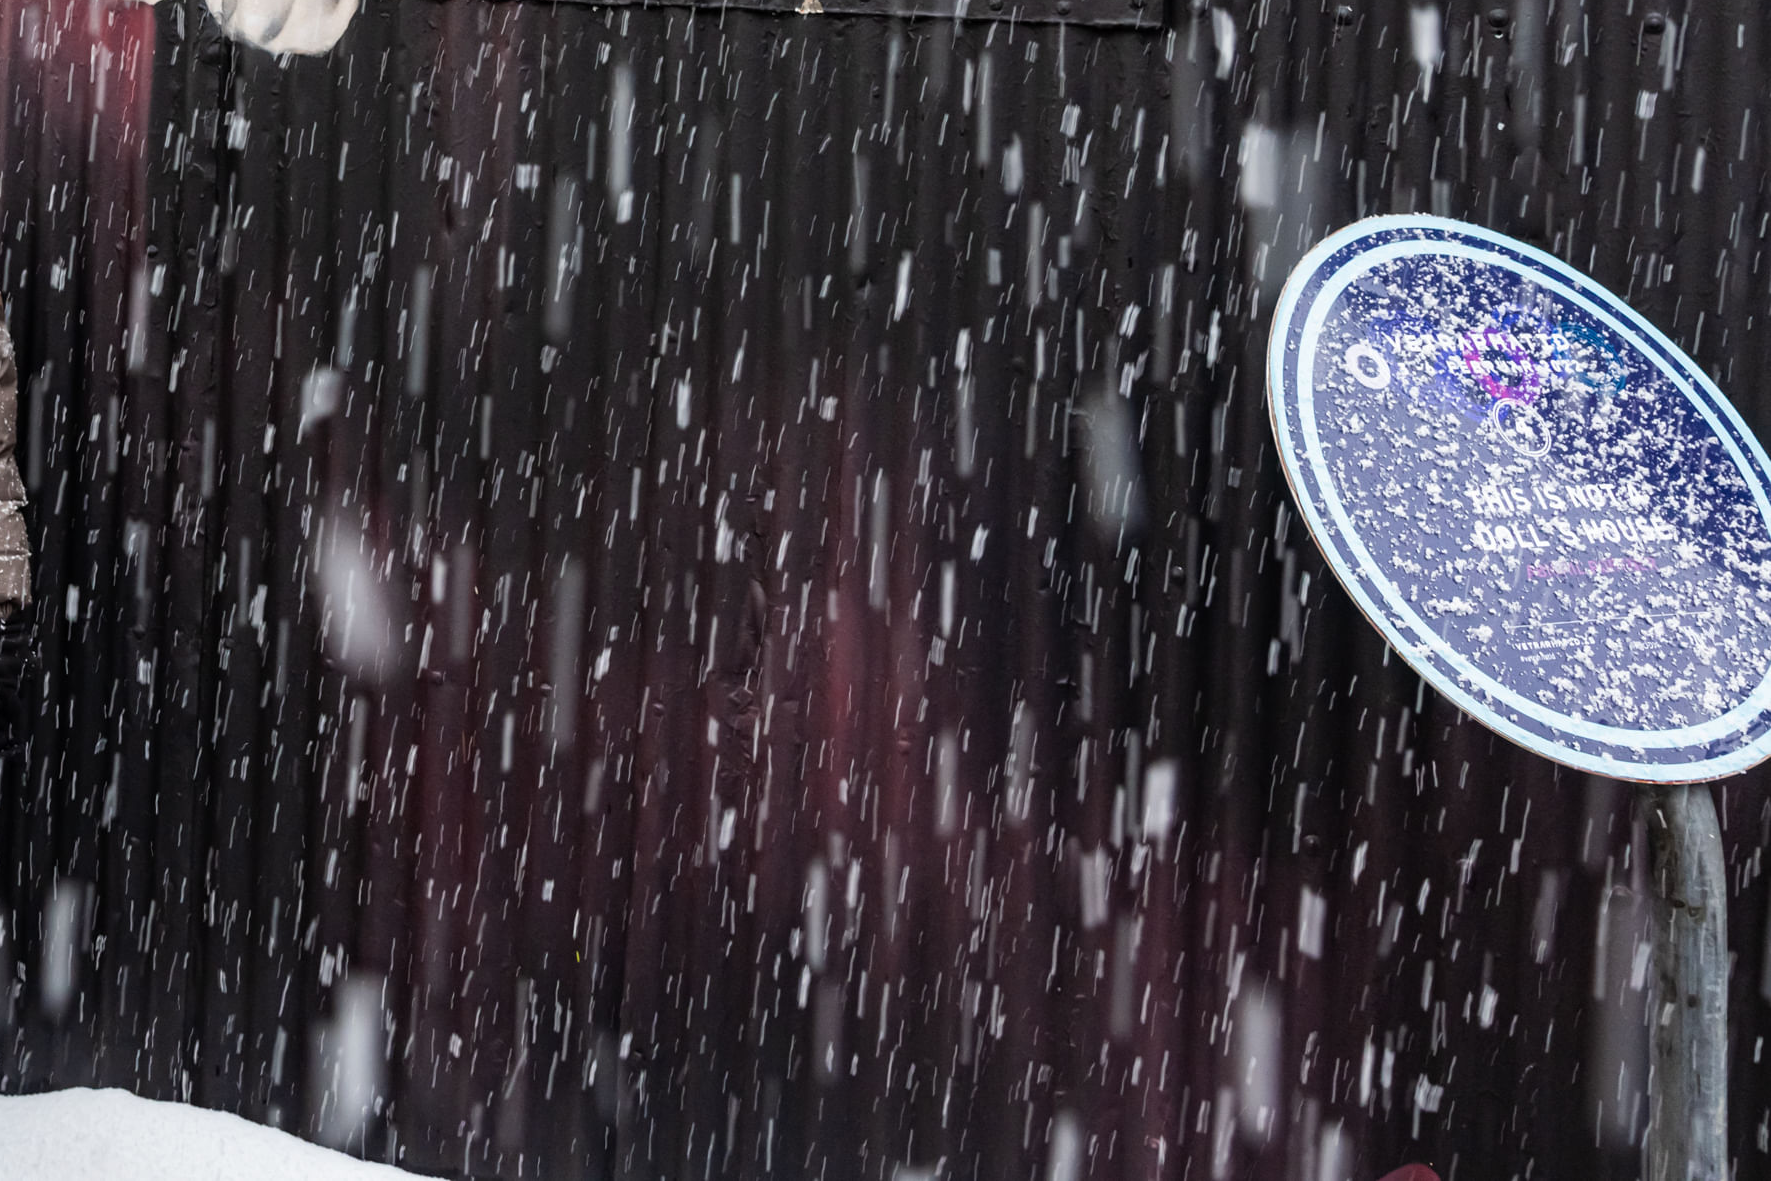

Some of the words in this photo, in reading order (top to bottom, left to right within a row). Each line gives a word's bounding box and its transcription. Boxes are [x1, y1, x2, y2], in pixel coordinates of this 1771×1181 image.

[1464, 486, 1531, 513] THIS
[1534, 485, 1566, 510] IS
[1566, 484, 1619, 509] NOT
[1580, 516, 1674, 544] HOUSE
